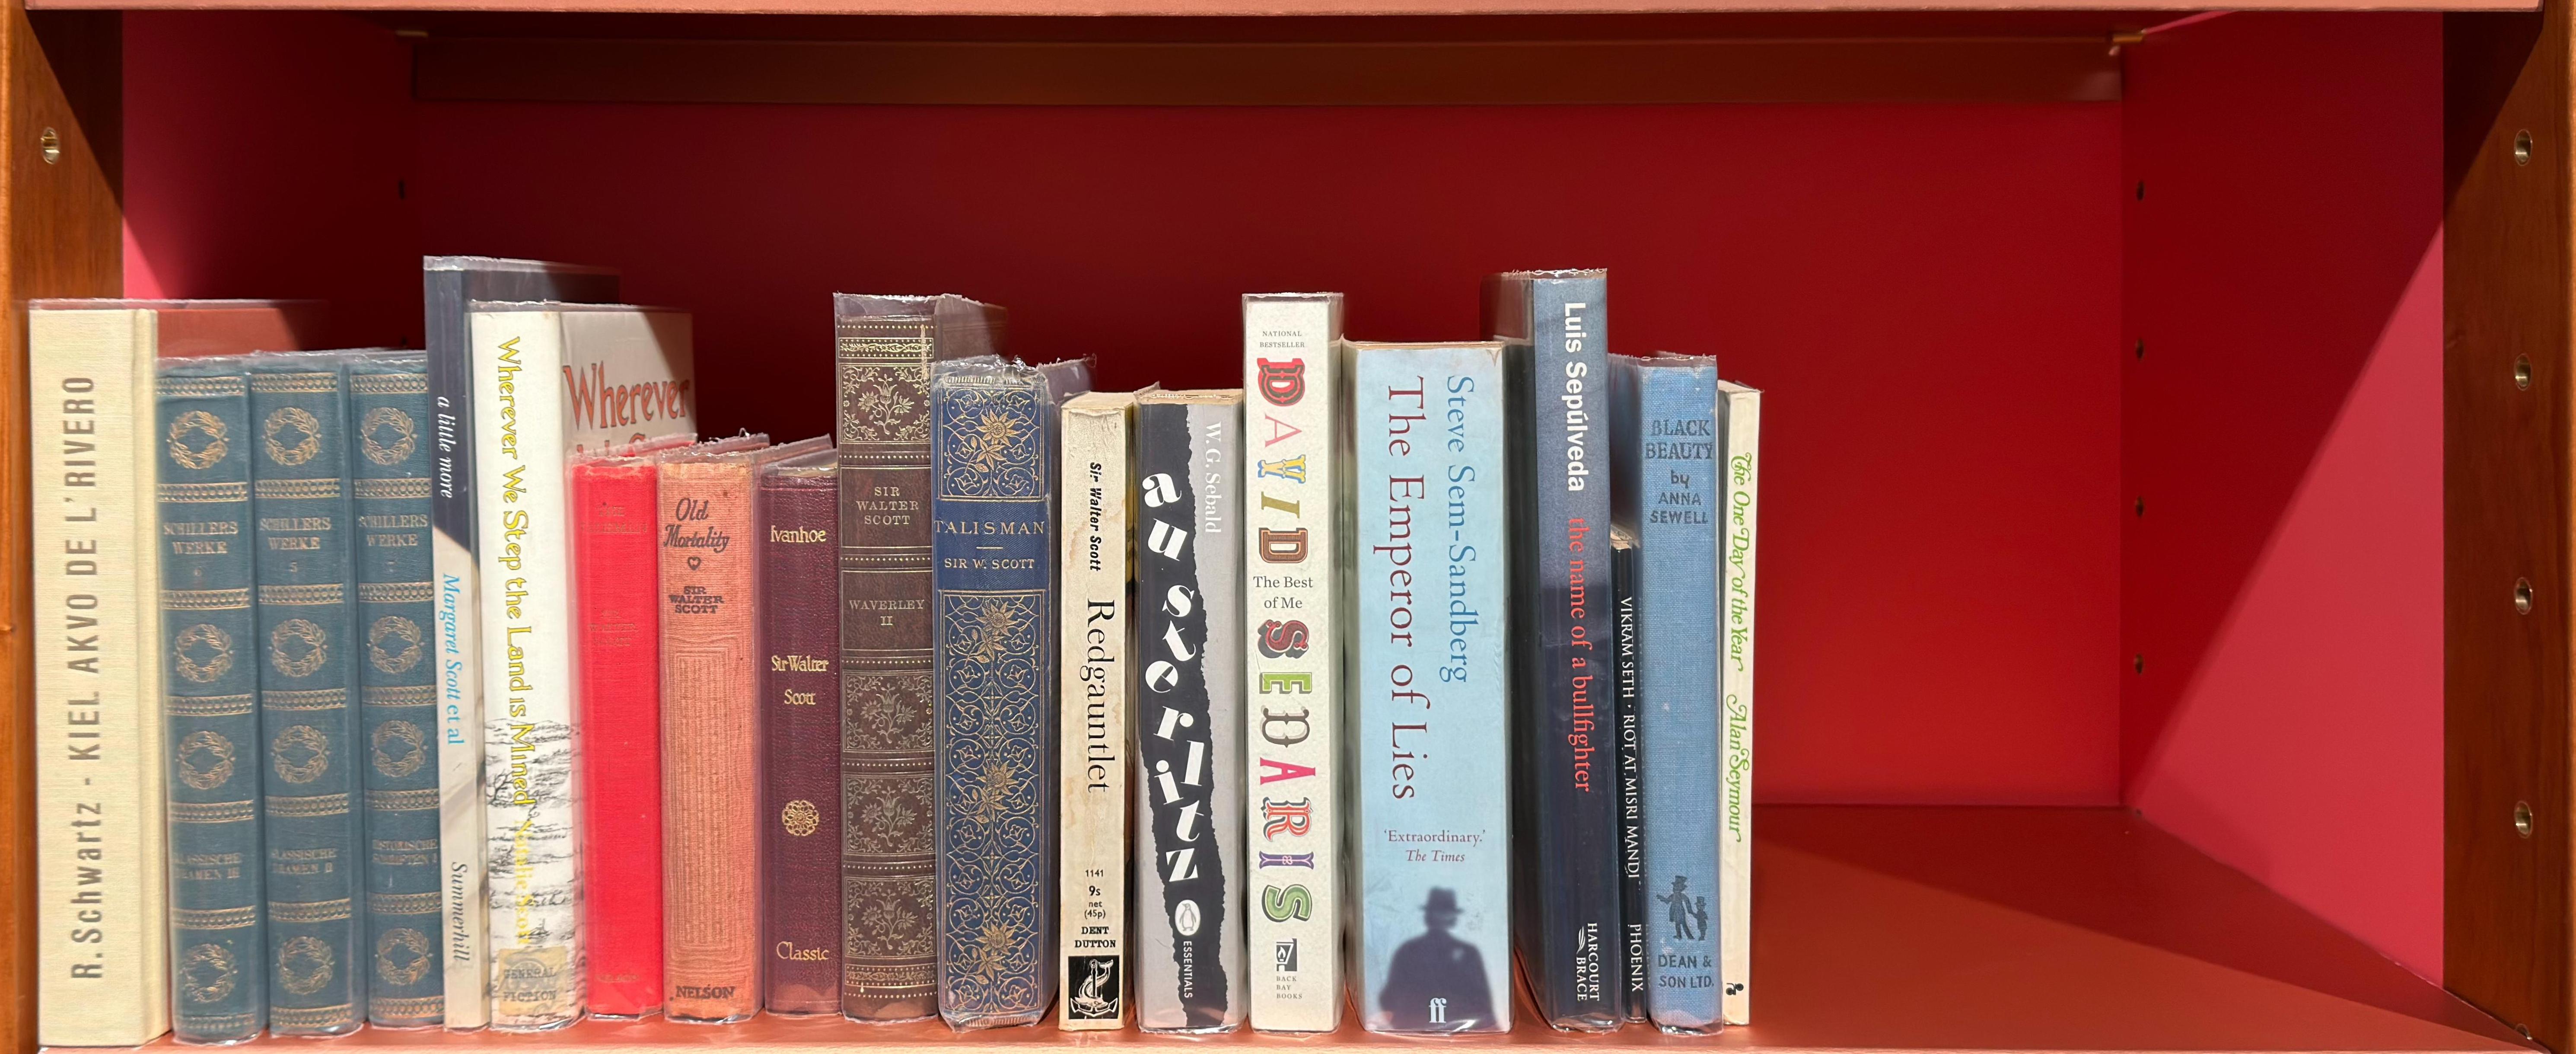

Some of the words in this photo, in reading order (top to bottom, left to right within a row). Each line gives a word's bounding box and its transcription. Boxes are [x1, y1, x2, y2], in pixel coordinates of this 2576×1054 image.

[1565, 303, 1587, 353] Luis
[437, 396, 450, 408] a
[498, 336, 522, 460] Wherever
[562, 360, 690, 431] Wherever
[1388, 375, 1427, 457] The
[1446, 375, 1474, 453] Steve
[1561, 361, 1589, 491] Sepúlveda
[1652, 418, 1710, 436] BLACK
[438, 414, 457, 452] little
[1205, 422, 1221, 444] W.
[1205, 448, 1221, 468] G.
[1257, 358, 1308, 564] DAVID
[1645, 442, 1713, 460] BEAUTY
[439, 457, 452, 498] more
[503, 465, 526, 504] We
[1090, 462, 1102, 482] Sir
[1670, 470, 1690, 489] by
[1731, 452, 1752, 485] The
[855, 501, 919, 511] WALTER
[874, 487, 900, 497] SIR
[1205, 473, 1222, 533] Sebald
[1658, 492, 1701, 505] ANNA
[1733, 491, 1750, 526] One
[260, 517, 332, 531] SCHILLERS
[359, 514, 428, 527] SCHILLERS
[675, 497, 709, 521] Old
[864, 515, 910, 525] SCOTT
[1090, 488, 1102, 531] Walter
[1649, 510, 1708, 524] SEWELL
[268, 537, 321, 549] WERKE
[367, 534, 418, 546] WERKE
[498, 510, 529, 570] Step
[664, 524, 730, 553] Mortality
[770, 524, 827, 543] Ivanhoe
[934, 520, 1044, 534] TALISMAN
[1569, 517, 1591, 553] the
[65, 540, 97, 575] DE
[172, 541, 228, 554] WERKE
[944, 558, 968, 569] SIR
[973, 559, 987, 569] W.
[992, 559, 1035, 569] SCOTT
[1090, 535, 1102, 572] Scott
[1373, 474, 1425, 647] Emperor
[1729, 528, 1750, 579] Day
[683, 585, 707, 595] SIR
[1253, 576, 1280, 588] The
[1284, 576, 1314, 588] Best
[1439, 465, 1479, 682] Sem-Sandberg
[1570, 559, 1585, 619] name
[1732, 577, 1748, 598] of
[439, 573, 460, 654] Margaret
[505, 578, 529, 619] the
[668, 595, 724, 604] WALTER
[675, 605, 718, 614] SCOTT
[849, 599, 924, 610] WAVERLEY
[1264, 597, 1278, 609] of
[1281, 597, 1302, 609] Me
[1731, 598, 1748, 625] the
[66, 594, 99, 674] AKVO
[880, 616, 893, 626] II
[1621, 596, 1634, 656] VIKRAM
[1571, 626, 1593, 651] of
[1731, 628, 1748, 672] Year
[506, 626, 533, 692] Land
[771, 655, 789, 671] Sir
[787, 655, 829, 671] Walter
[1572, 657, 1587, 669] a
[445, 659, 462, 700] Scott
[1142, 473, 1204, 882] austerlitz
[1391, 664, 1430, 709] of
[1622, 662, 1634, 698] SETH
[784, 689, 816, 705] Scott
[1079, 598, 1115, 793] Redgauntlet
[67, 691, 101, 760] KIEL
[447, 704, 461, 723] et
[1726, 694, 1748, 751] Alan
[447, 728, 465, 744] al
[1568, 675, 1595, 792] bullfighter
[1623, 715, 1636, 750] RIOT
[510, 723, 537, 805] Mined
[1258, 619, 1316, 923] SEDARIS
[1392, 722, 1428, 799] Lies
[1624, 755, 1637, 772] AT
[1625, 778, 1638, 819] MISRI
[1726, 748, 1749, 843] Seymour
[514, 820, 534, 890] Natalie
[1406, 849, 1427, 862] The
[1431, 850, 1465, 862] Times
[1627, 826, 1640, 878] MANDI
[1085, 869, 1104, 877] 1141
[70, 802, 103, 979] R.Schwartz
[1089, 885, 1101, 896] 9s
[451, 862, 471, 961] Summerhill
[516, 894, 535, 945] Scott
[1084, 909, 1106, 920] (45p)
[1074, 939, 1116, 948] DUTTON
[1081, 926, 1109, 935] DENT
[776, 941, 830, 961] Classic
[1587, 923, 1600, 1001] HARCOURT
[1630, 924, 1643, 992] PHOENIX
[1658, 954, 1697, 968] DEAN
[1702, 955, 1711, 968] &
[504, 967, 557, 979] GENERAL
[1183, 941, 1193, 998] ESSENTIALS
[1576, 957, 1587, 1001] BRACE
[1659, 975, 1685, 988] SON
[503, 990, 557, 1003] FICTION
[676, 986, 736, 999] NELSON
